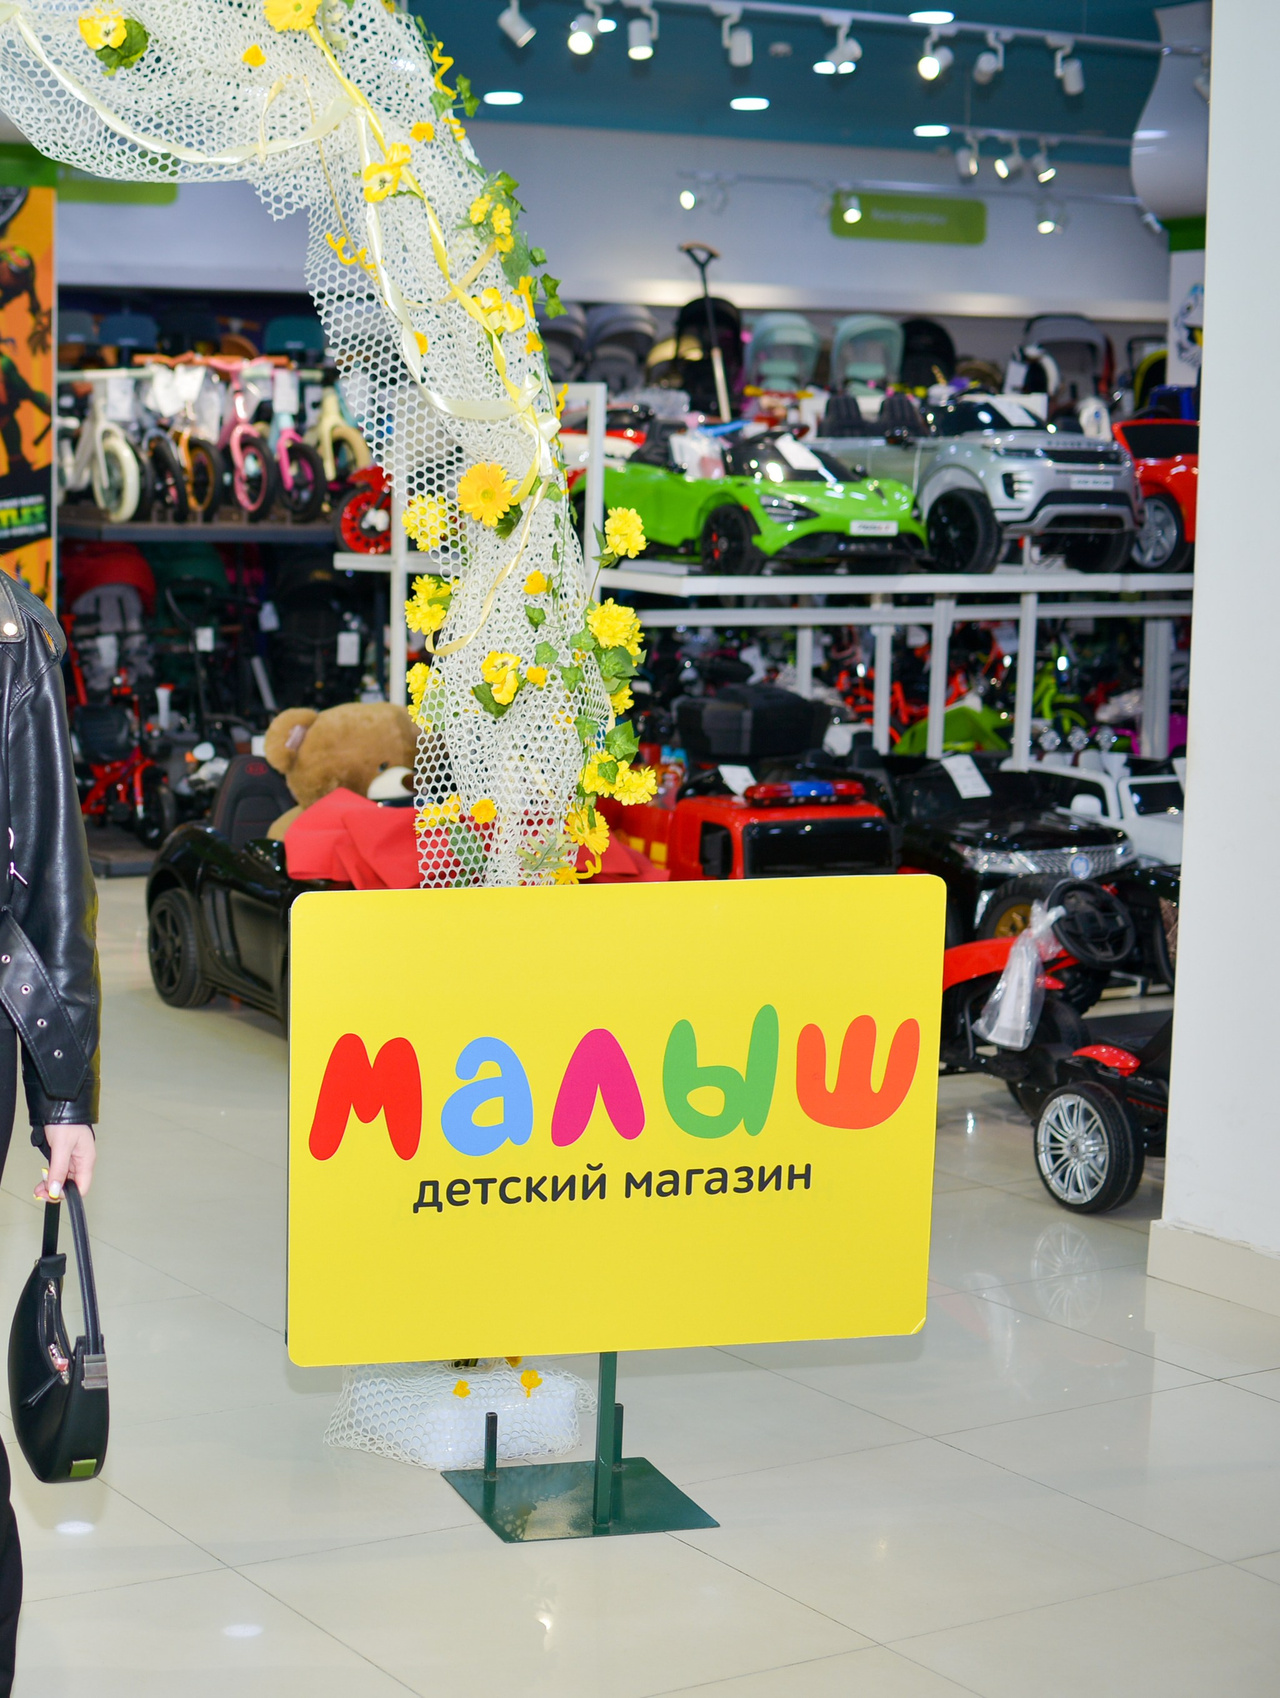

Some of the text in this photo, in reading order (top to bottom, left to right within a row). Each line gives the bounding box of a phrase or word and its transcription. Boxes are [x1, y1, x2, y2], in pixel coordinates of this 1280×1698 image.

[308, 1003, 921, 1162] малыш
[412, 1162, 812, 1213] детский магазин
